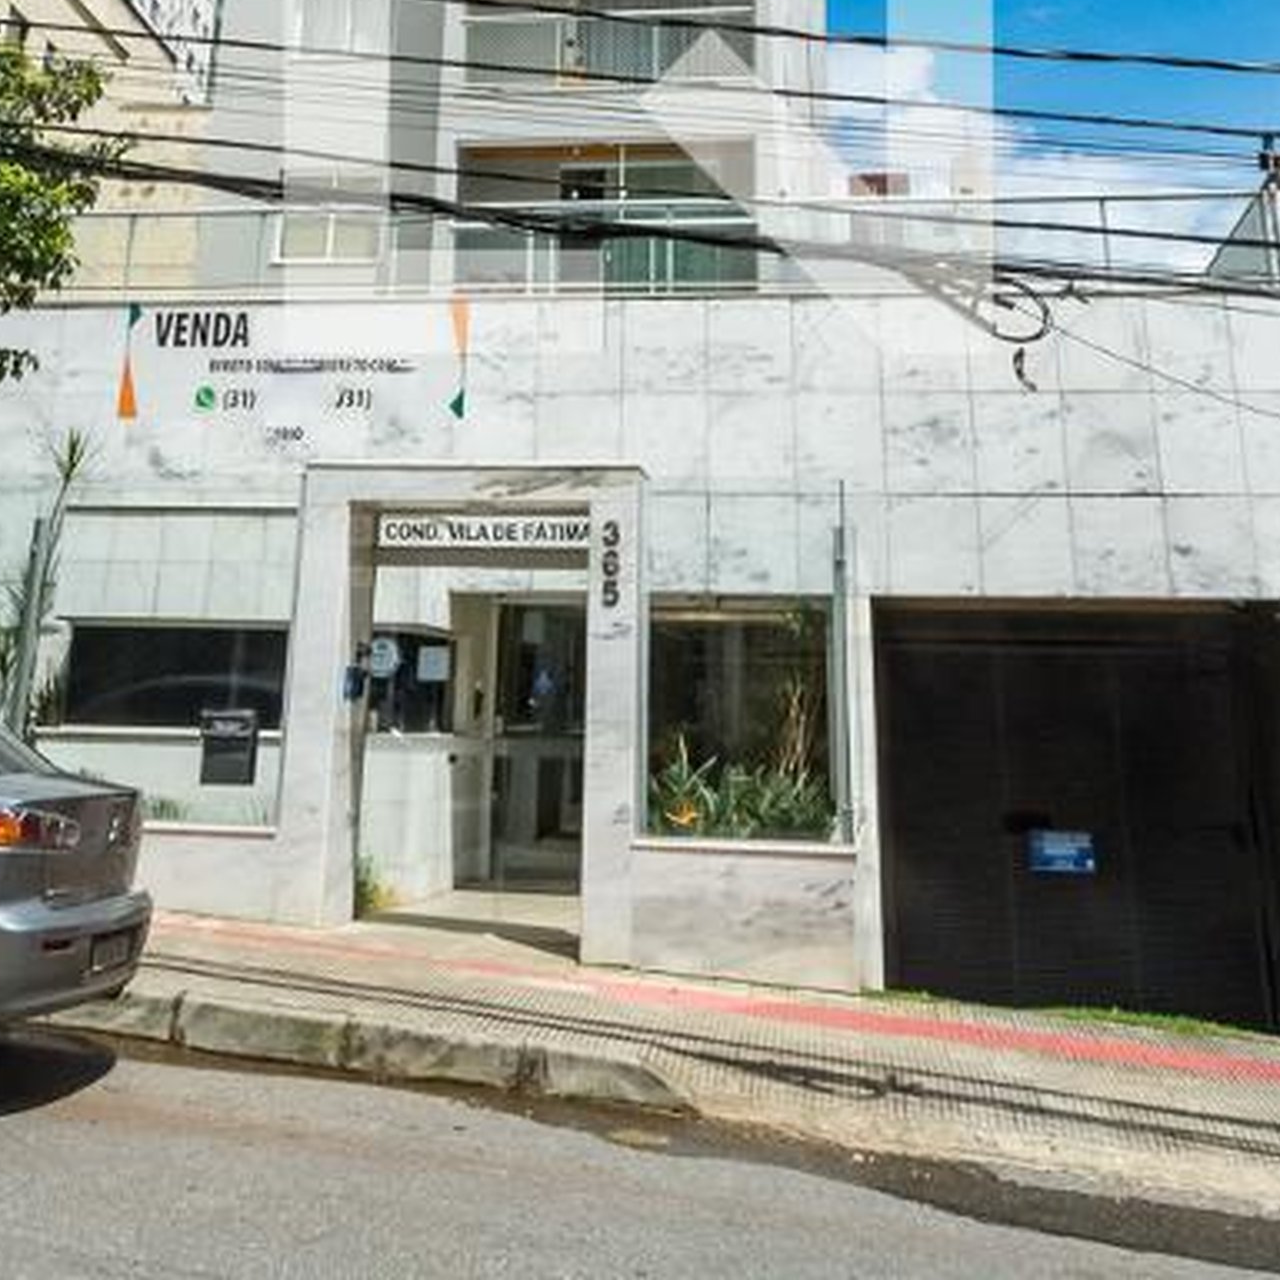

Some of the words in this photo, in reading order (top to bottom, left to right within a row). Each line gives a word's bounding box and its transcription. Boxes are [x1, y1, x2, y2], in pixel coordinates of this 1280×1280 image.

[156, 312, 249, 348] VENDA
[223, 389, 256, 409] (31)
[385, 523, 443, 540] COND.
[448, 522, 489, 540] VILA
[493, 522, 518, 540] DE
[602, 521, 620, 607] 365
